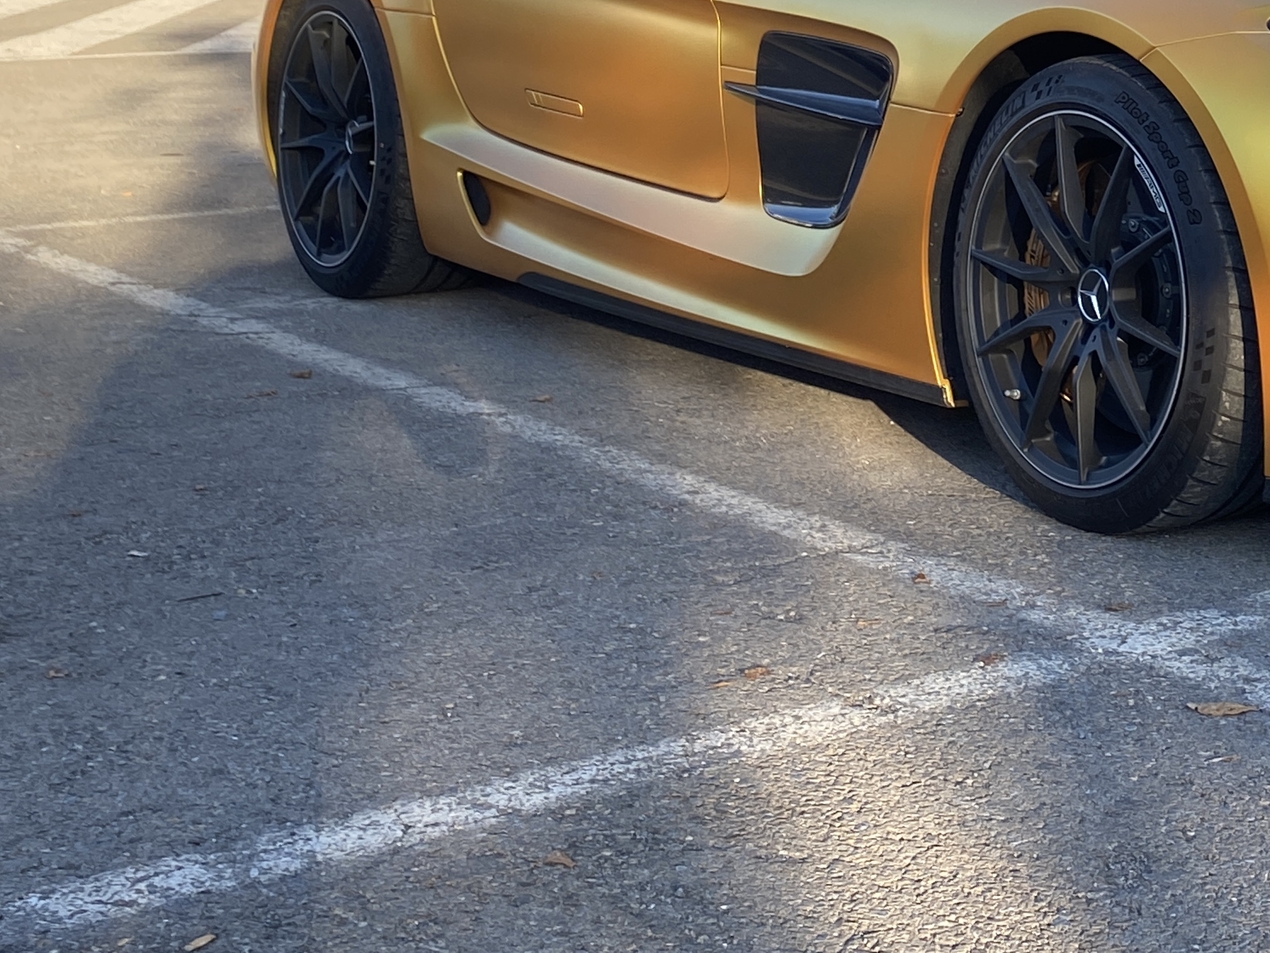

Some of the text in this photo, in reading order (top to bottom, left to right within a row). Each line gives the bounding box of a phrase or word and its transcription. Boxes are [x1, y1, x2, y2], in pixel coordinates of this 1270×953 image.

[1144, 121, 1180, 169] Sport
[1173, 170, 1194, 206] Cup
[1186, 208, 1203, 225] 2
